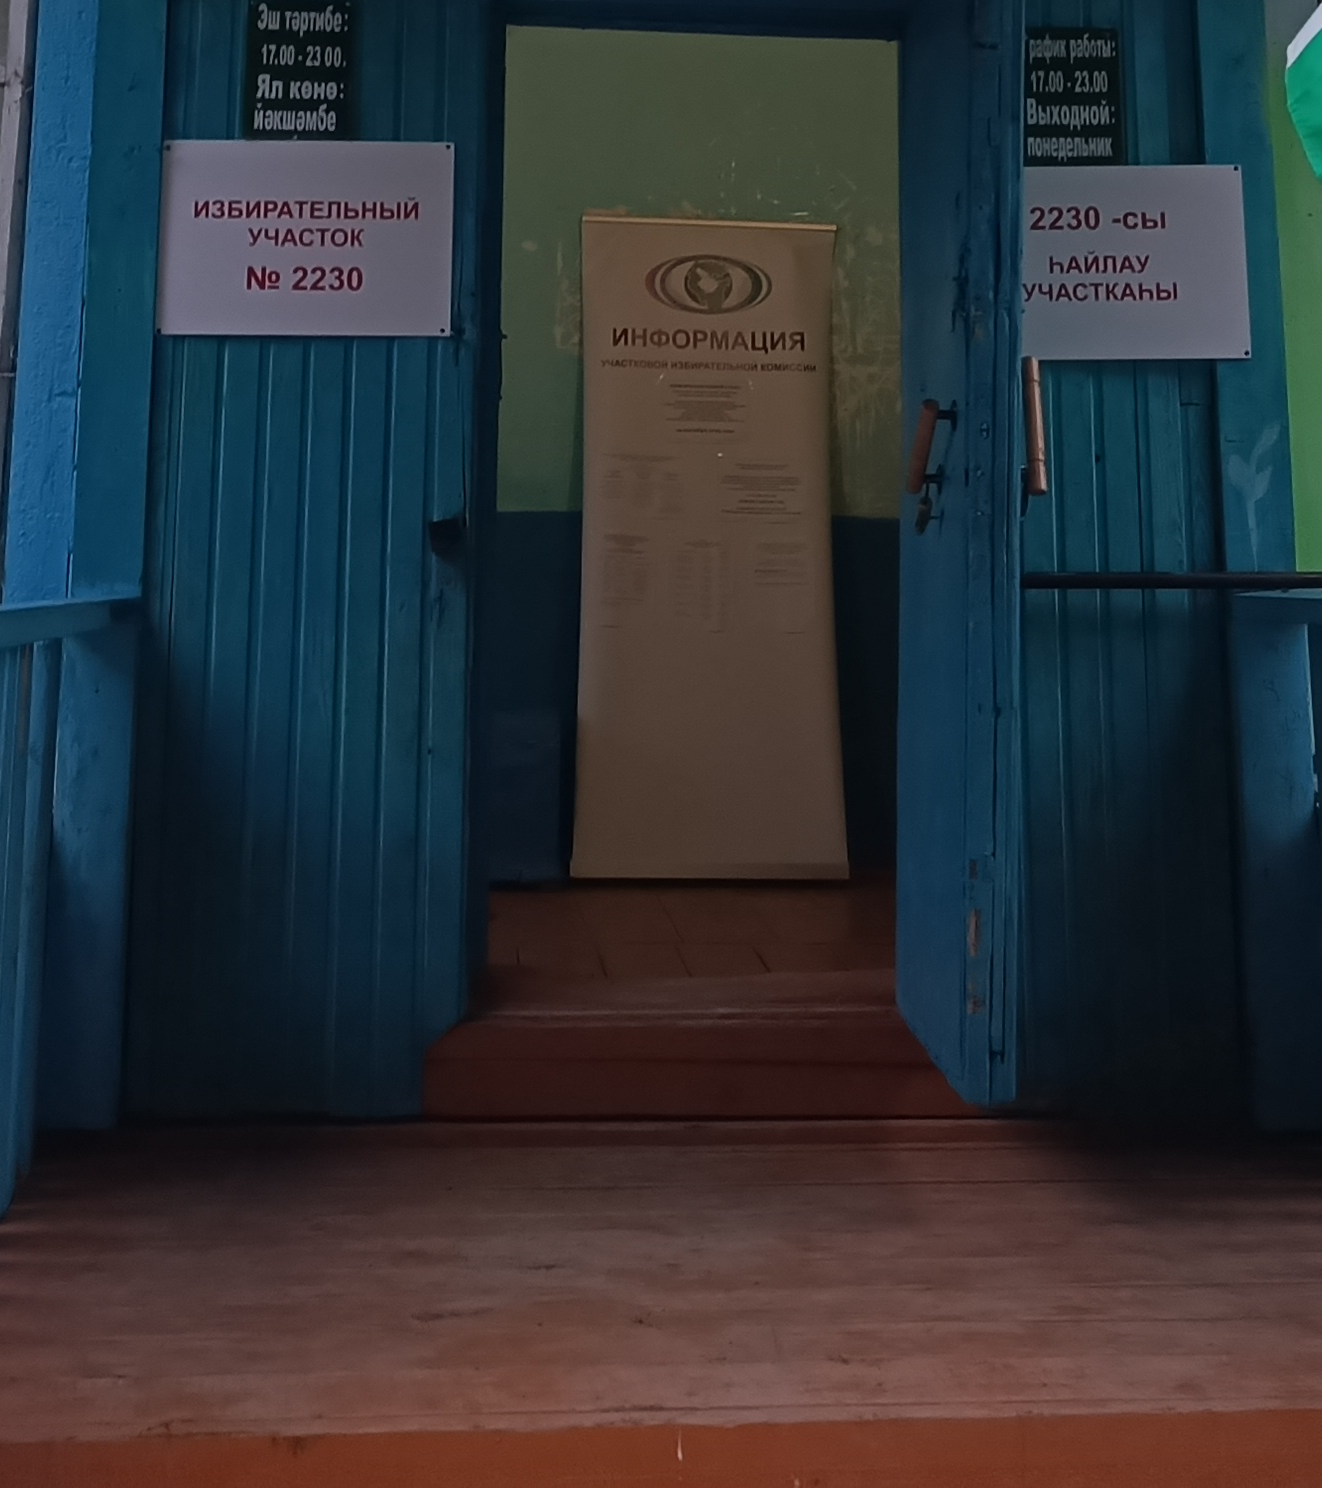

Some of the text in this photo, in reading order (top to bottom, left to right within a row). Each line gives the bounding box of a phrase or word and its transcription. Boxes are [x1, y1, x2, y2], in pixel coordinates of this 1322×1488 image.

[257, 2, 281, 30] Эш
[261, 43, 295, 66] 17.00
[1024, 32, 1116, 64] рафик работы:
[255, 73, 283, 100] Ял
[1030, 70, 1064, 93] 17.00
[1074, 70, 1108, 93] 23.00
[253, 102, 337, 132] йәкшәмбе
[1026, 97, 1115, 131] Выходной:
[1027, 137, 1113, 162] понедельник
[193, 196, 420, 221] ИЗБИРАТЕЛЬНЫЙ
[1028, 205, 1101, 231] 2230
[247, 227, 365, 248] УЧАСТОК
[245, 265, 364, 292] № 2230
[611, 326, 806, 355] ИНФОРМАЦИЯ
[760, 362, 817, 373] КОМИССИИ
